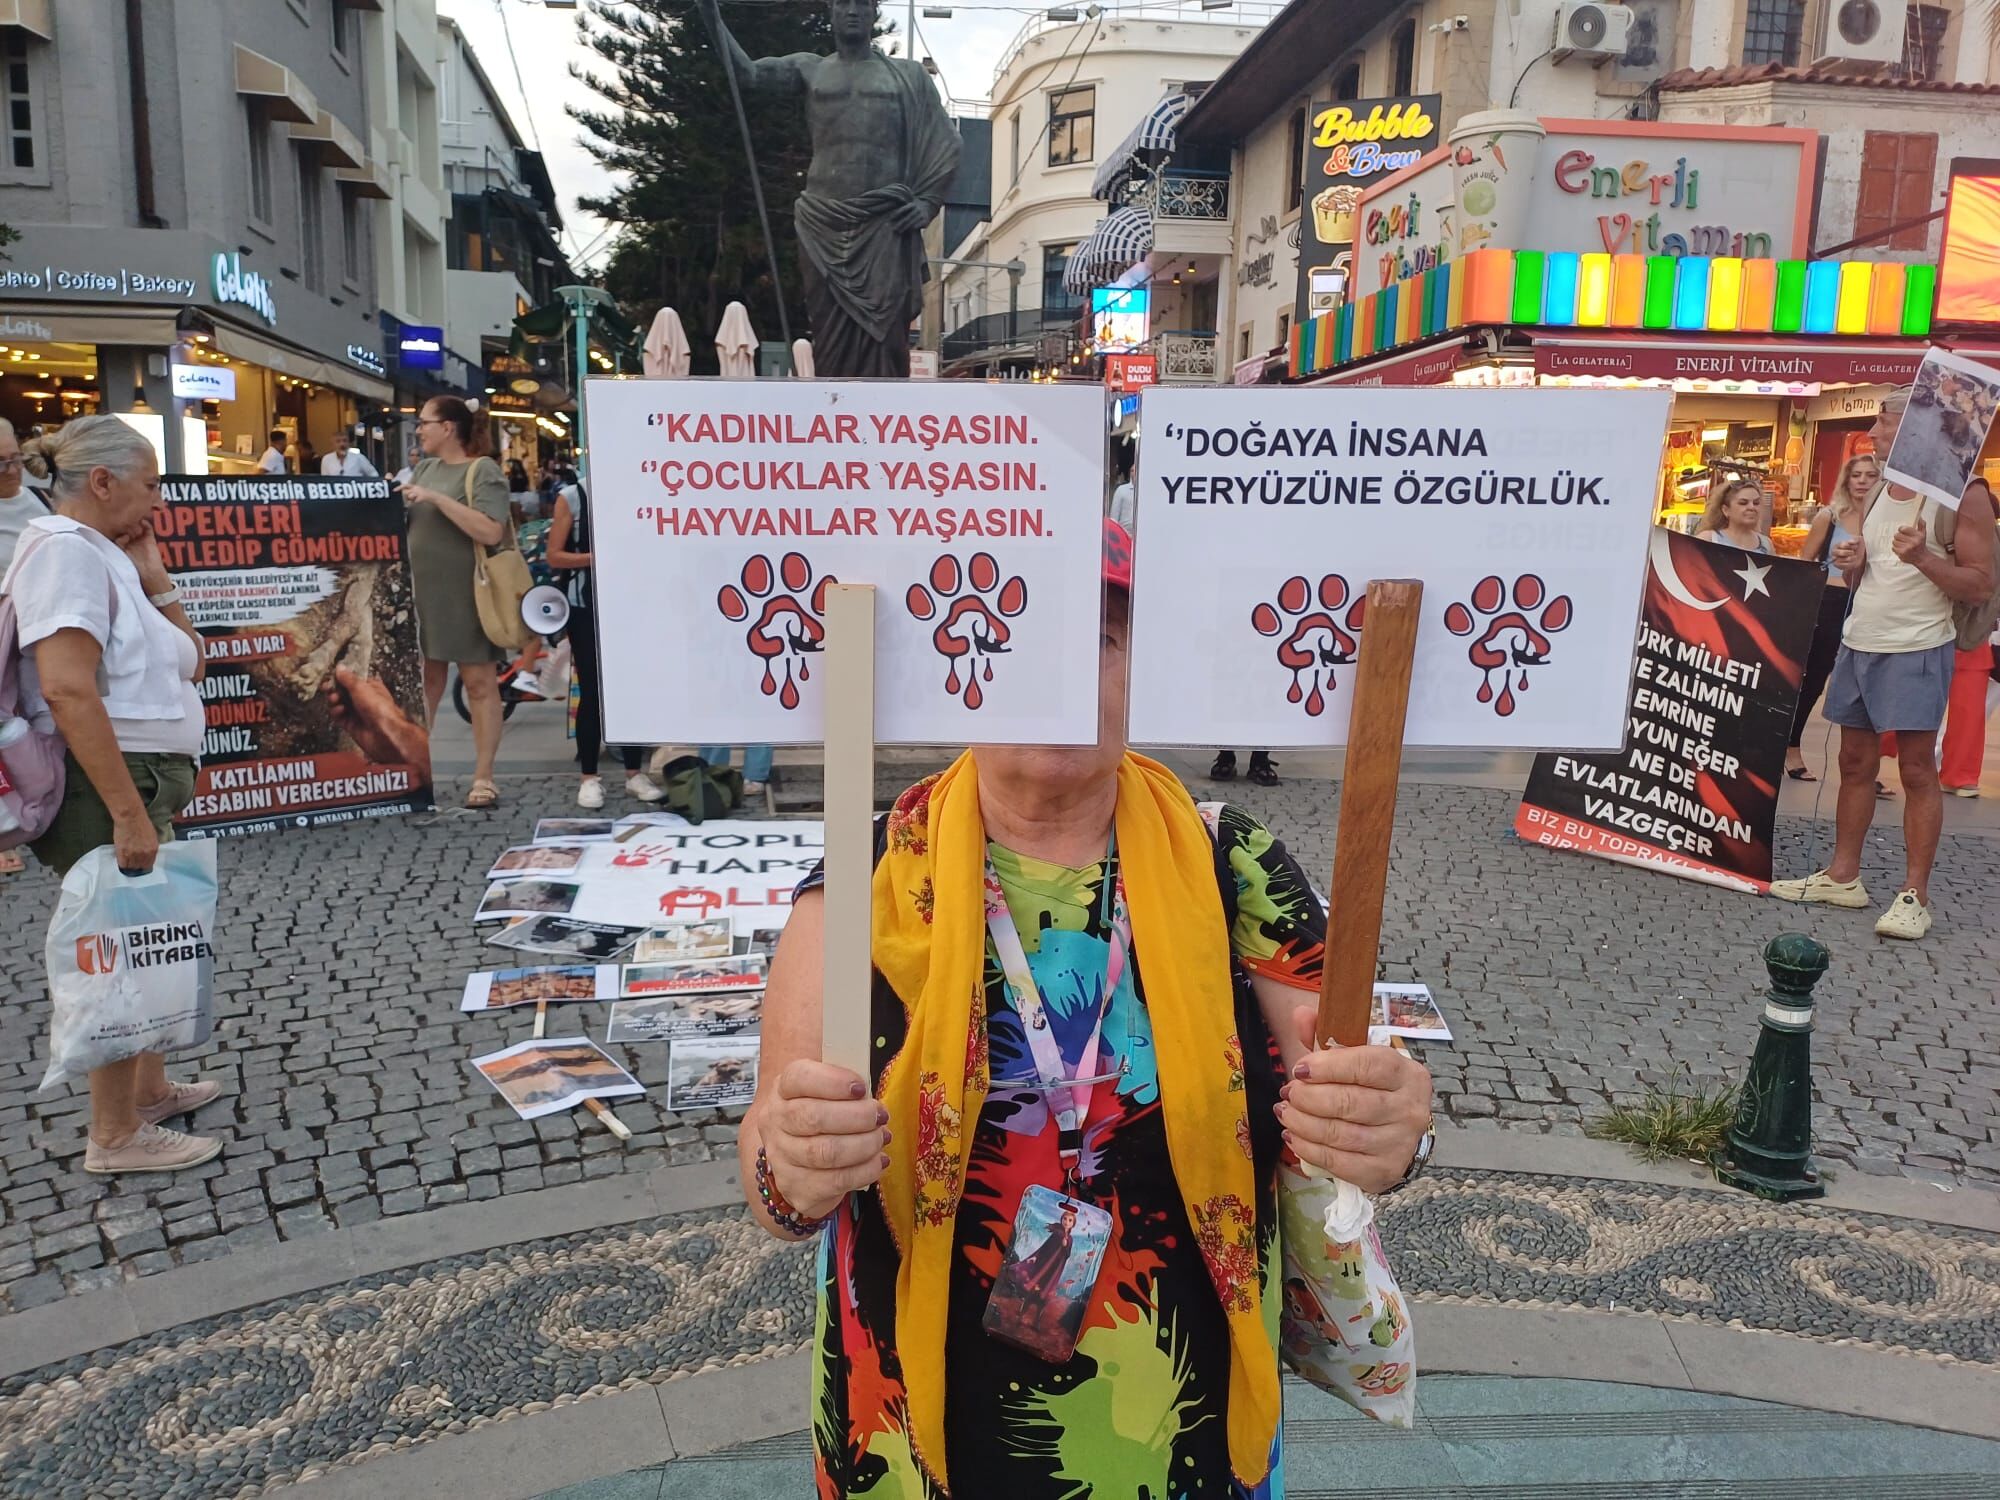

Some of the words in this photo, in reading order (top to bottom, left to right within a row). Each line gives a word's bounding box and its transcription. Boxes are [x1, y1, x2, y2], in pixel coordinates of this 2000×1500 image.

[1312, 102, 1434, 148] Bubble
[56, 270, 118, 291] Coffee
[131, 273, 196, 298] Bakery
[1127, 364, 1152, 374] DUDU
[1675, 354, 1735, 373] ENERJİ
[1740, 355, 1814, 375] VİTAMİN
[870, 414, 1038, 451] YAŞASIN.
[1348, 421, 1489, 458] İNSANA
[205, 479, 305, 504] BÜYÜKŞEHİR
[308, 478, 391, 500] BELEDİYESİ
[879, 461, 1047, 498] YAŞASIN.
[1160, 469, 1383, 506] YERYÜZÜNE
[1393, 469, 1612, 507] ÖZGÜRLÜK.
[153, 500, 302, 538] ÖPEKLERİ
[887, 507, 1054, 544] YAŞASIN.
[158, 532, 262, 569] ATLEDİP
[271, 531, 400, 564] GÖMÜYOR!
[231, 638, 251, 656] DA
[253, 634, 286, 655] VAR!
[1676, 639, 1762, 690] MİLLETİ
[197, 674, 257, 700] ADINIZ.
[1635, 656, 1653, 681] E
[1655, 663, 1745, 717] ZALİMİN
[1633, 688, 1716, 738] EMRİNE
[209, 760, 316, 790] KATLİAMIN
[1629, 748, 1665, 778] NE
[1668, 762, 1697, 792] DE
[182, 788, 273, 818] HESABINI
[276, 769, 409, 806] VERECEKSİNİZ!
[1553, 755, 1752, 844] EVLATLARINDAN
[1527, 808, 1559, 830] BİZ
[1563, 821, 1593, 840] BU
[1584, 794, 1713, 857] VAZGEÇER
